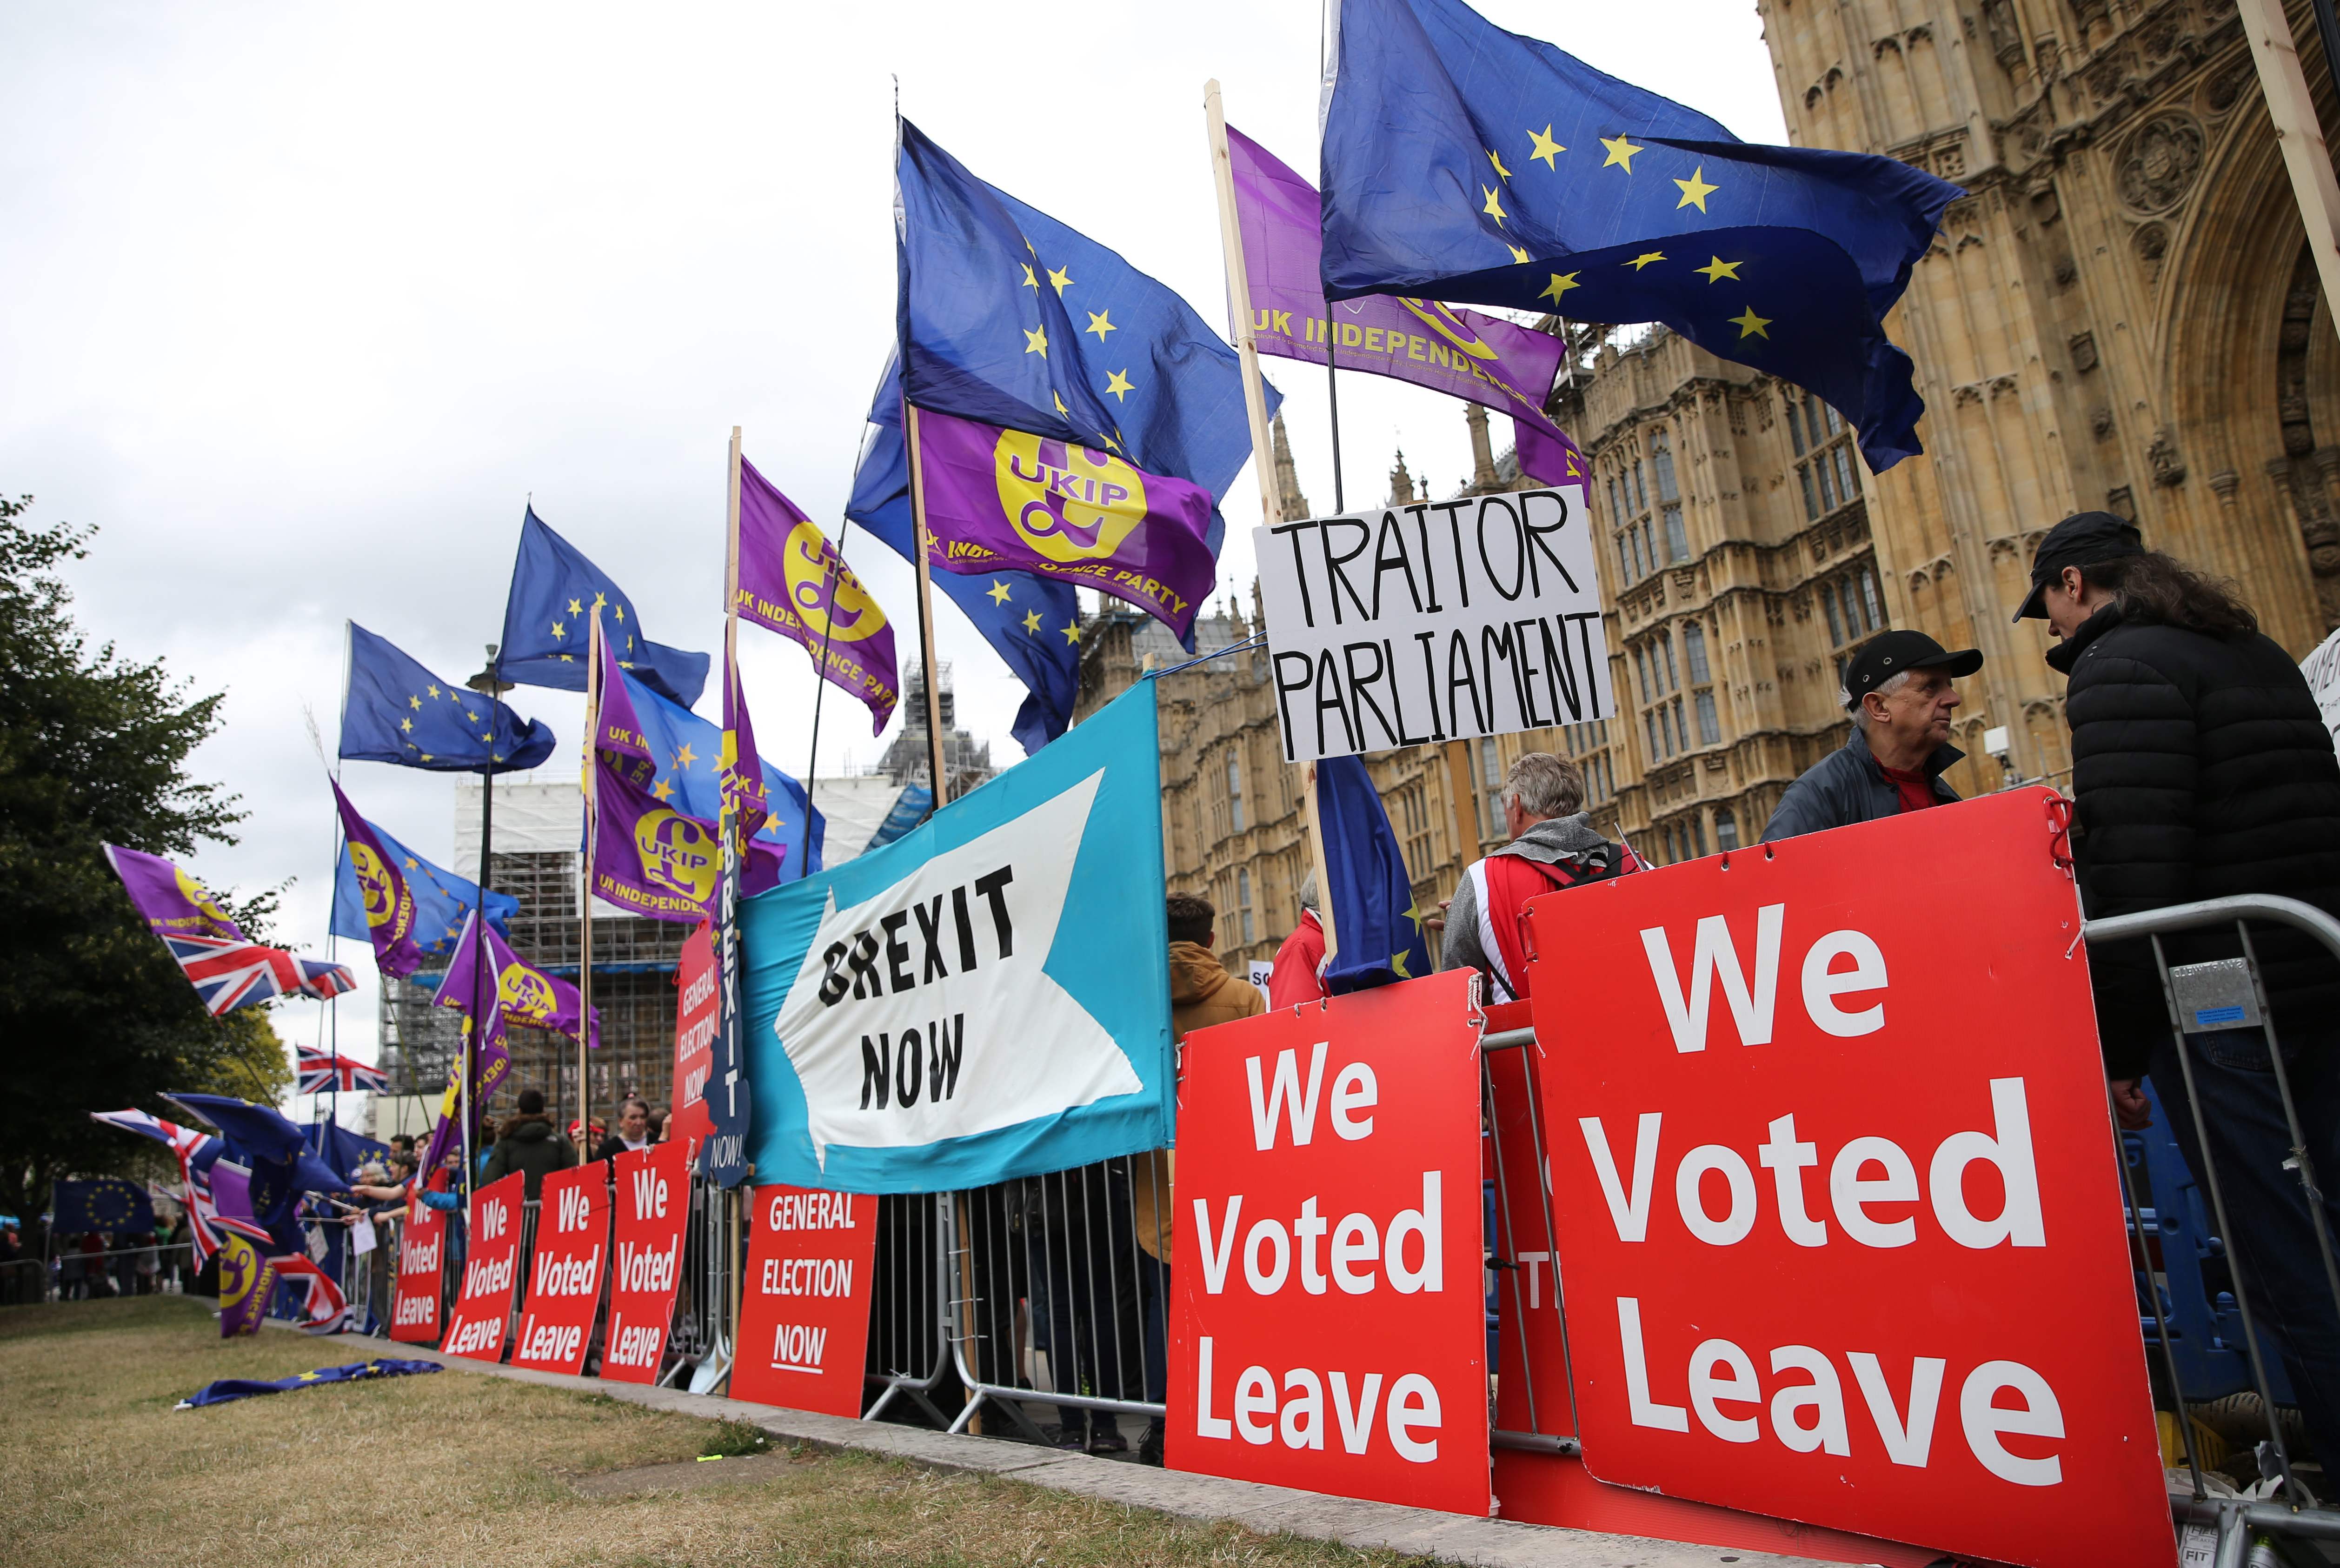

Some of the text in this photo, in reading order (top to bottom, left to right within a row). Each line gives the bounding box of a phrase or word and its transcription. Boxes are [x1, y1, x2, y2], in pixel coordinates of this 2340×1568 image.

[1251, 309, 1293, 337] UK
[1010, 454, 1129, 507] UKIP
[1271, 491, 1579, 627] TRAITOR
[1113, 570, 1189, 614] PARTY
[1273, 611, 1600, 761] PARLIAMENT
[609, 726, 631, 744] UK
[641, 836, 708, 869] UKIP
[599, 873, 615, 892] UK
[818, 864, 1013, 1008] BREXIT
[683, 963, 715, 1017] GENERAL
[721, 829, 738, 1117] BREXIT
[1639, 903, 1889, 1055] We
[679, 1010, 715, 1063] ELECTION
[859, 1013, 964, 1110] NOW
[685, 1064, 706, 1103] NOW
[1245, 1041, 1379, 1151] We
[710, 1133, 743, 1169] NOW!
[1578, 1076, 2047, 1249] Voted
[482, 1197, 508, 1242] We
[558, 1185, 590, 1233] We
[632, 1167, 668, 1221] We
[769, 1191, 856, 1232] GENERAL
[402, 1231, 439, 1276] Voted
[1192, 1170, 1443, 1296] Voted
[465, 1244, 515, 1301] Voted
[535, 1243, 600, 1297] Voted
[619, 1233, 678, 1293] Voted
[761, 1258, 853, 1298] ELECTION
[396, 1289, 435, 1326] Leave
[445, 1314, 501, 1355] Leave
[519, 1313, 582, 1362] Leave
[609, 1311, 660, 1368] Leave
[773, 1323, 827, 1365] NOW
[1197, 1336, 1442, 1463] Leave
[1616, 1296, 2067, 1487] Leave
[2186, 1550, 2208, 1561] FIT
